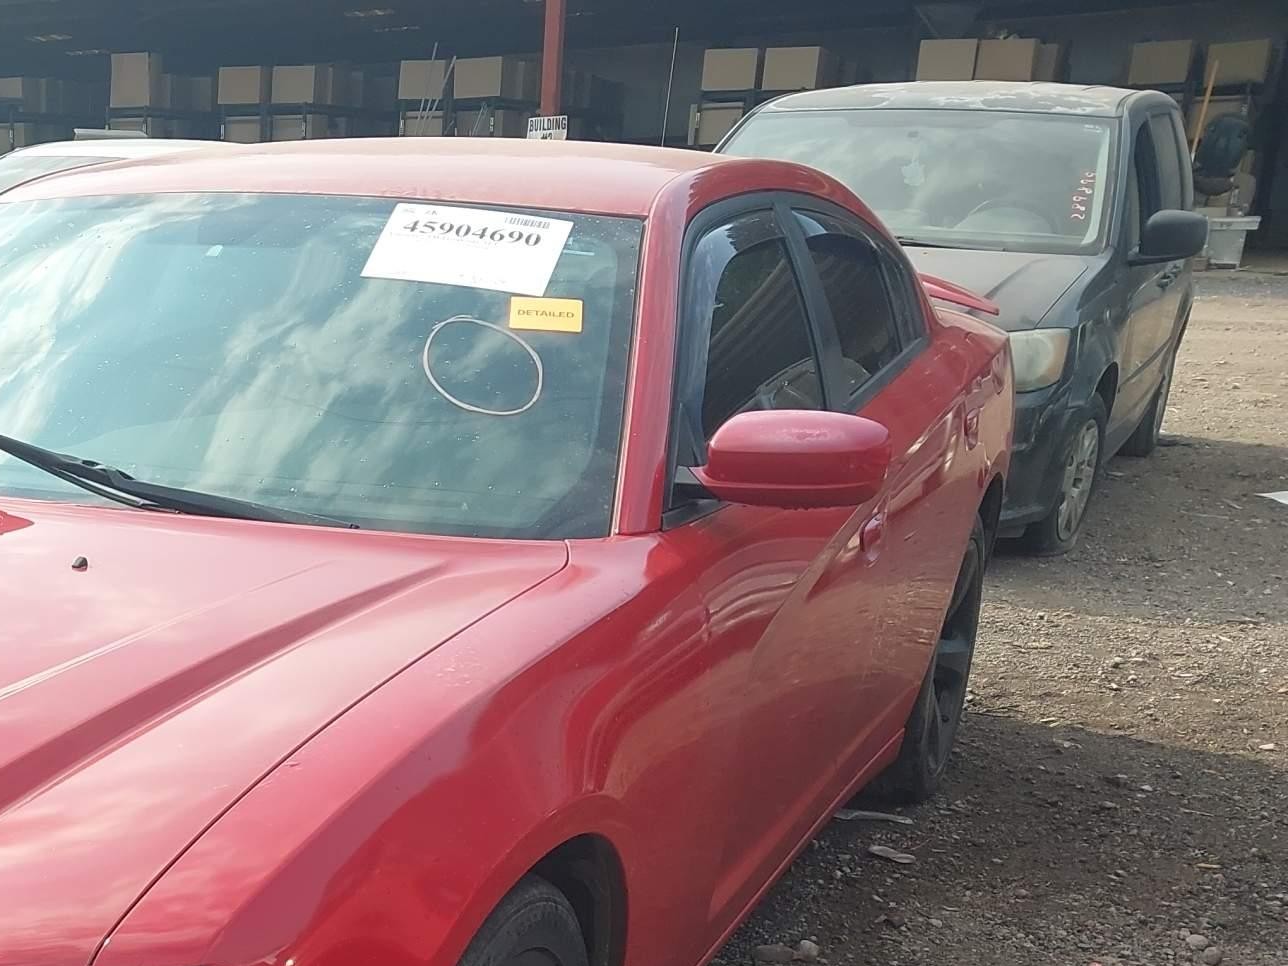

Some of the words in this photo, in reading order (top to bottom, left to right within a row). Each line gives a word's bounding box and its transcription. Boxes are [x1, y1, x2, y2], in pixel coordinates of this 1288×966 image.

[529, 117, 567, 132] BUILDING
[403, 219, 542, 248] 45904690
[516, 308, 575, 319] DETAILED
